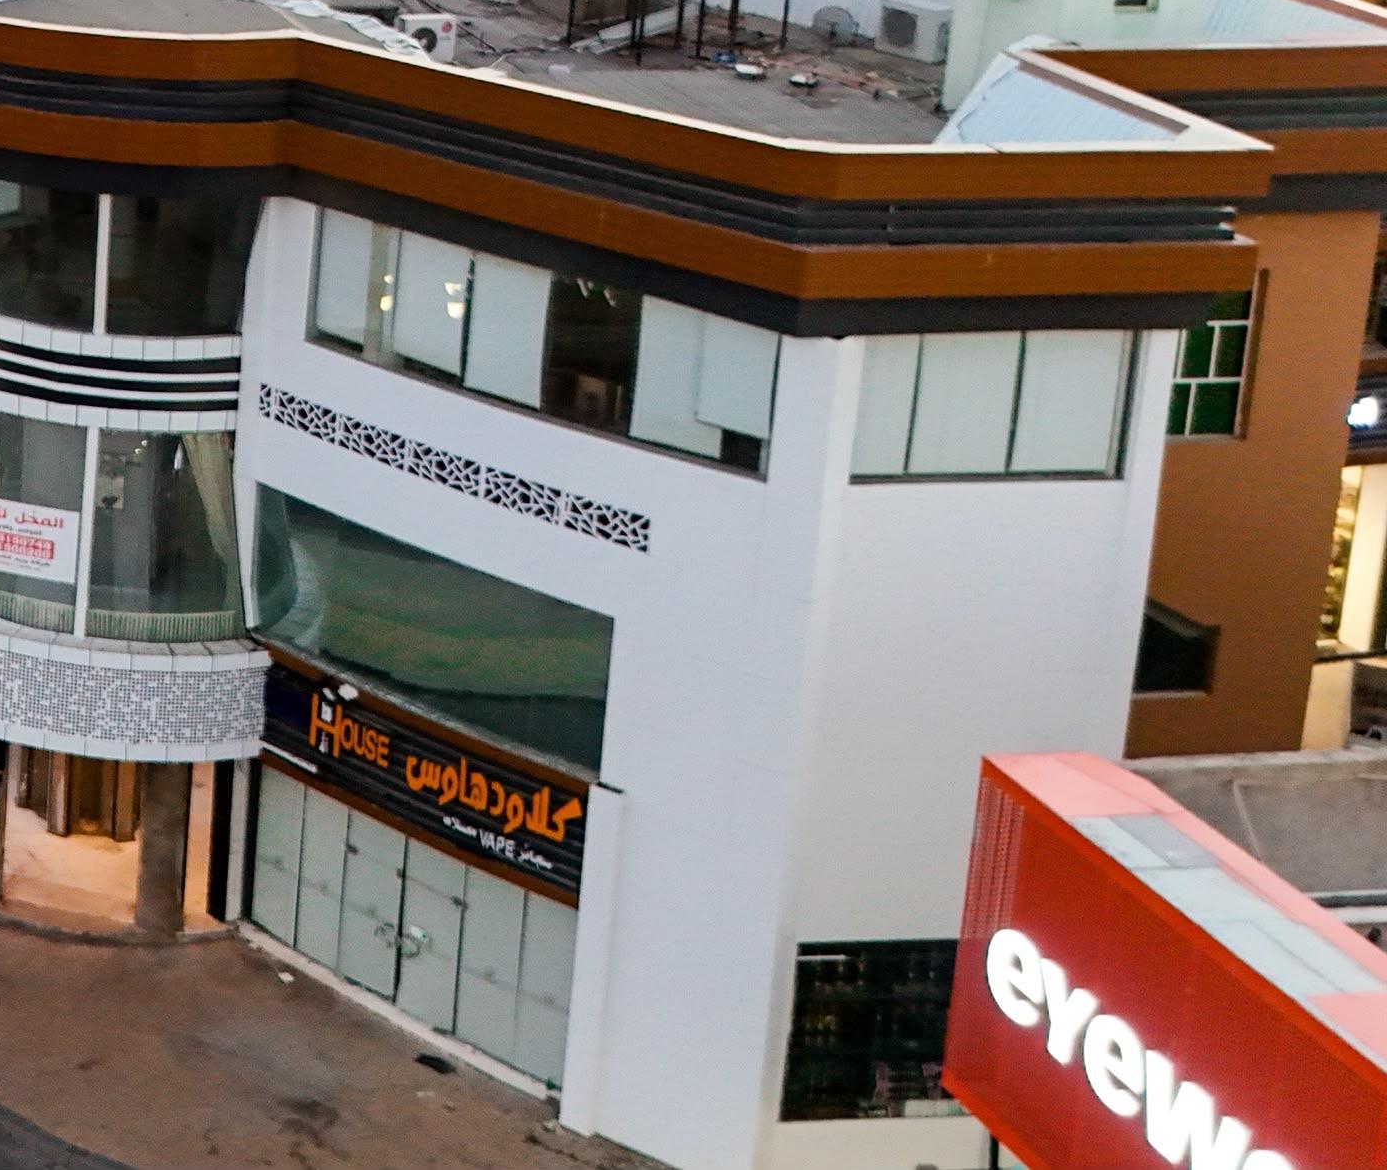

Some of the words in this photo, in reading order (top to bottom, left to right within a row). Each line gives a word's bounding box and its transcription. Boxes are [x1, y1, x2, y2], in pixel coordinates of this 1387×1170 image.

[308, 693, 391, 768] HOUSE
[479, 828, 517, 860] VAPE
[987, 928, 1295, 1170] eyew
